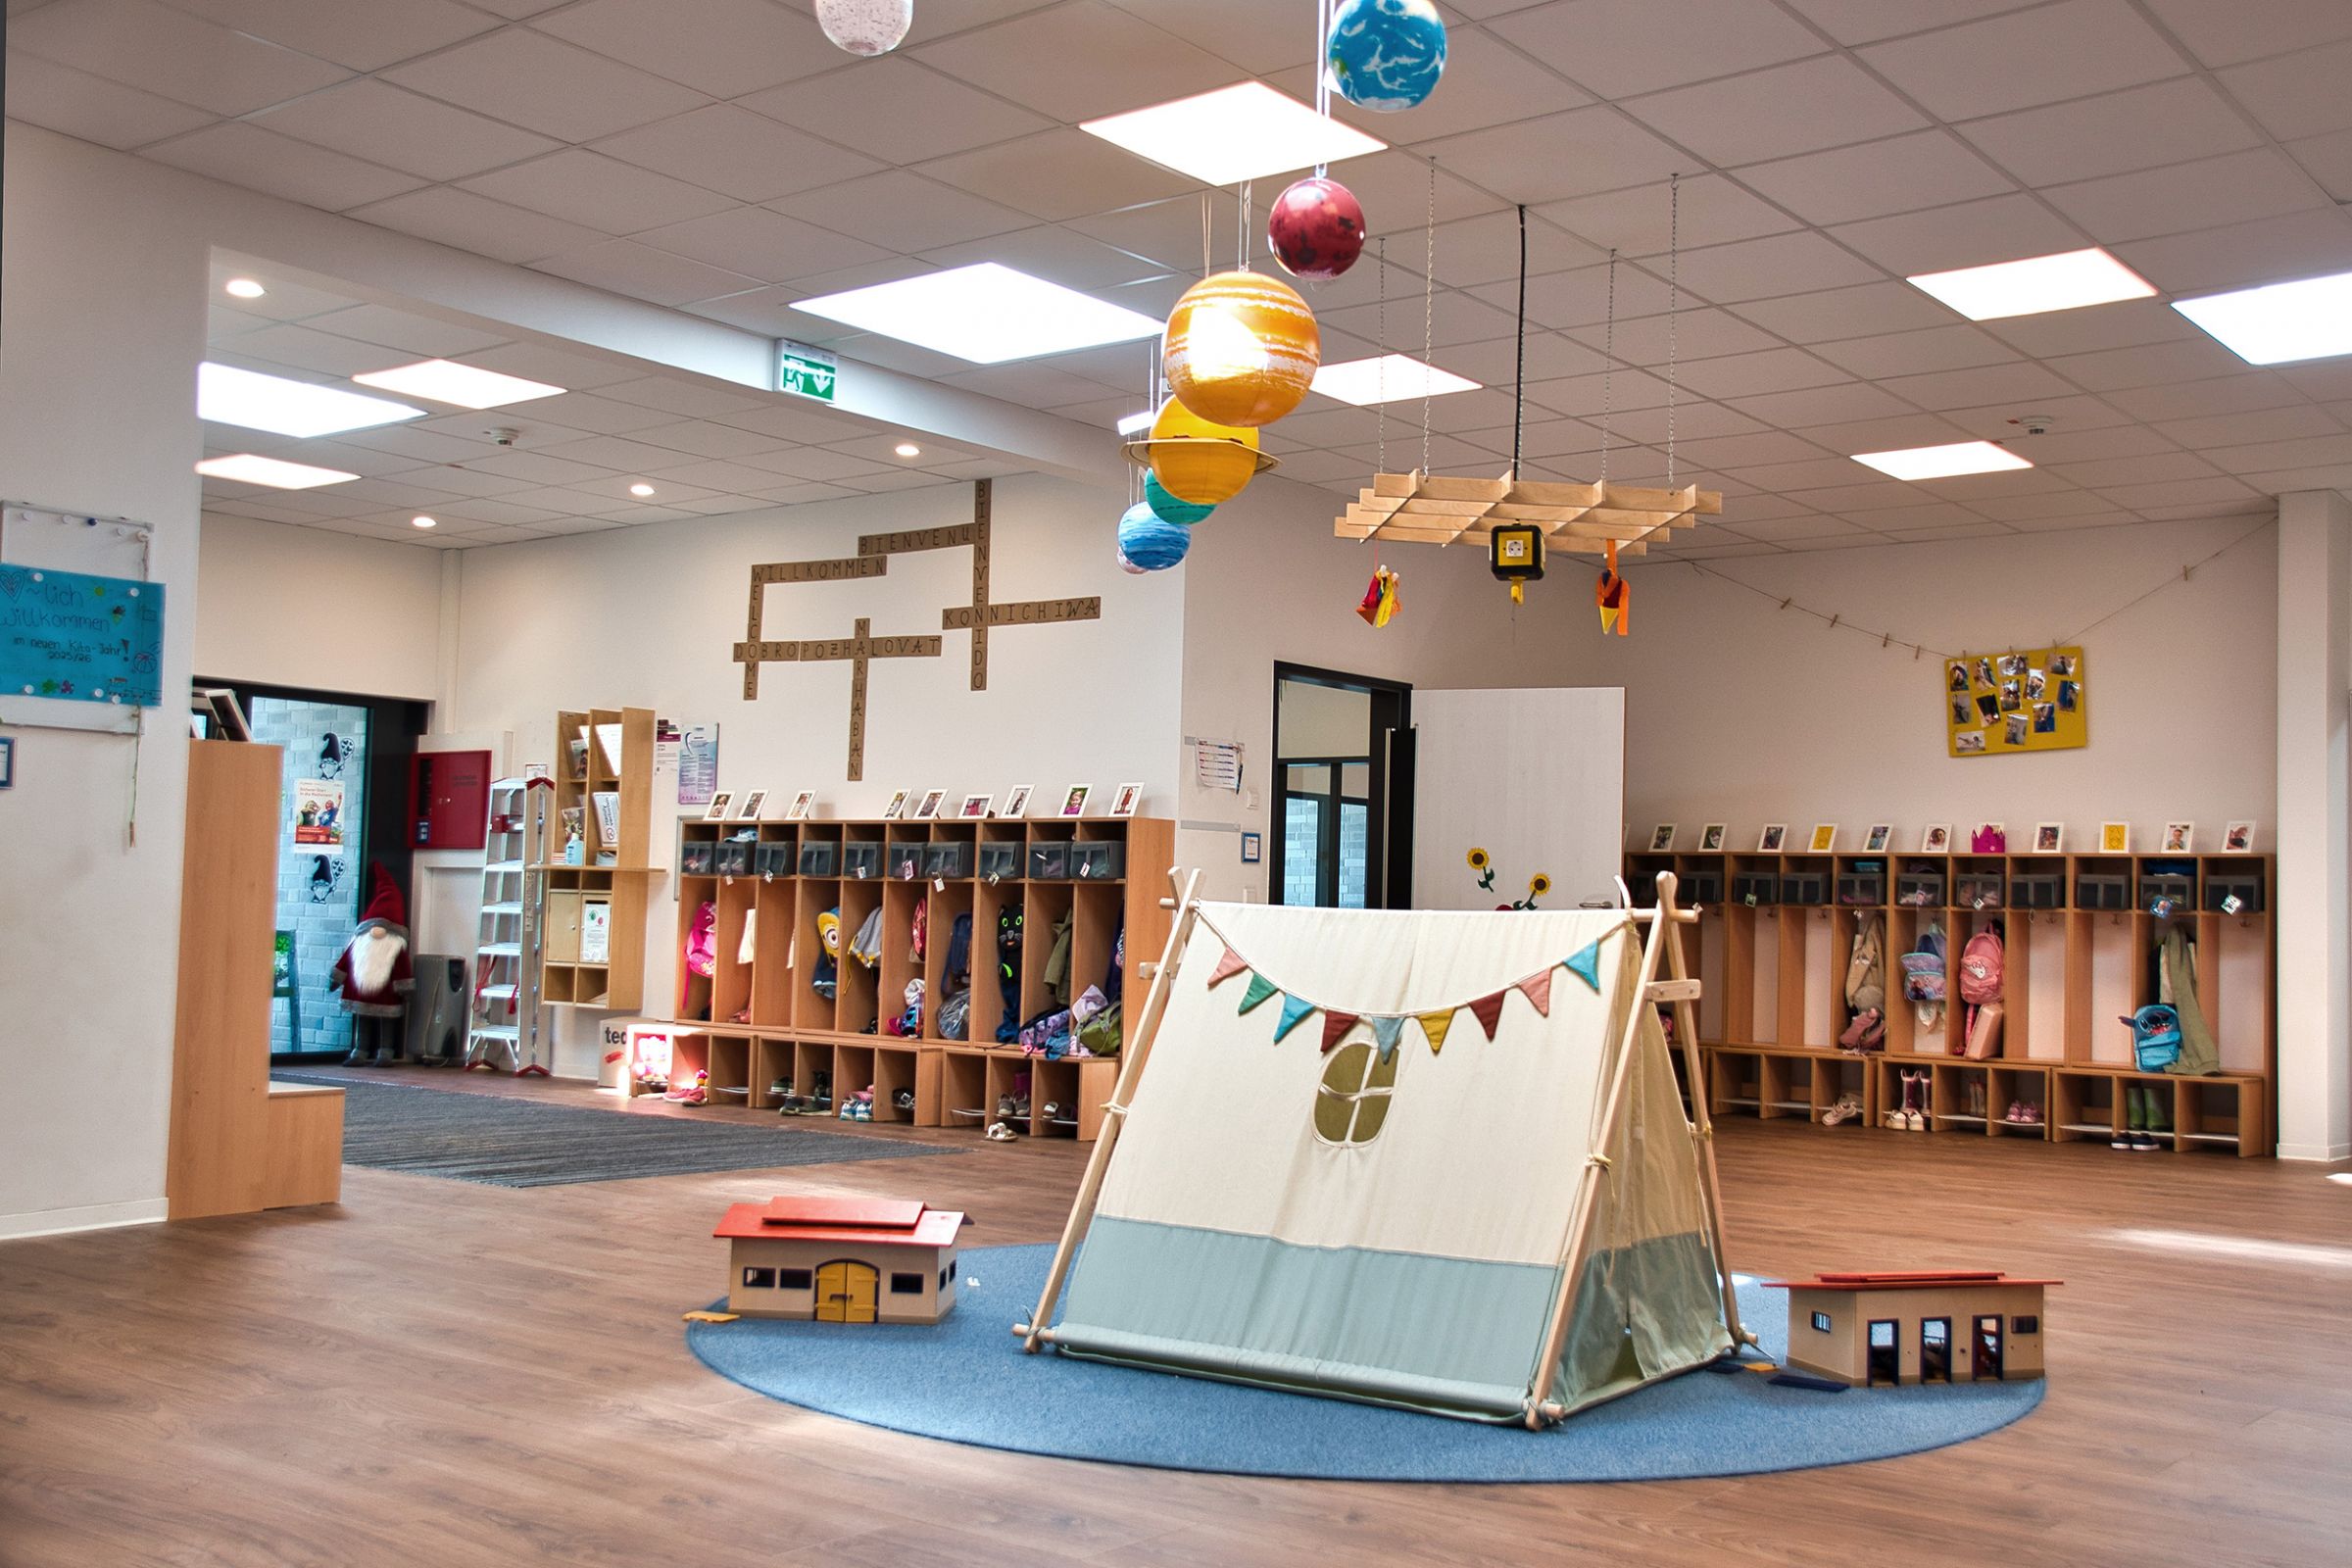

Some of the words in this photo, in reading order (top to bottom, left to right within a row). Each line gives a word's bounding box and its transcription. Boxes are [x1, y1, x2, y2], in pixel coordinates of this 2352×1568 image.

[860, 523, 985, 555] BIENVENUE
[753, 558, 884, 582] WILLKOMMEN
[973, 481, 988, 688] BIENVENIDO
[945, 599, 1099, 626] KONNICHIWA
[746, 567, 763, 698] WELCOME
[735, 643, 797, 660] DOBRO
[851, 620, 866, 777] MARHABAN
